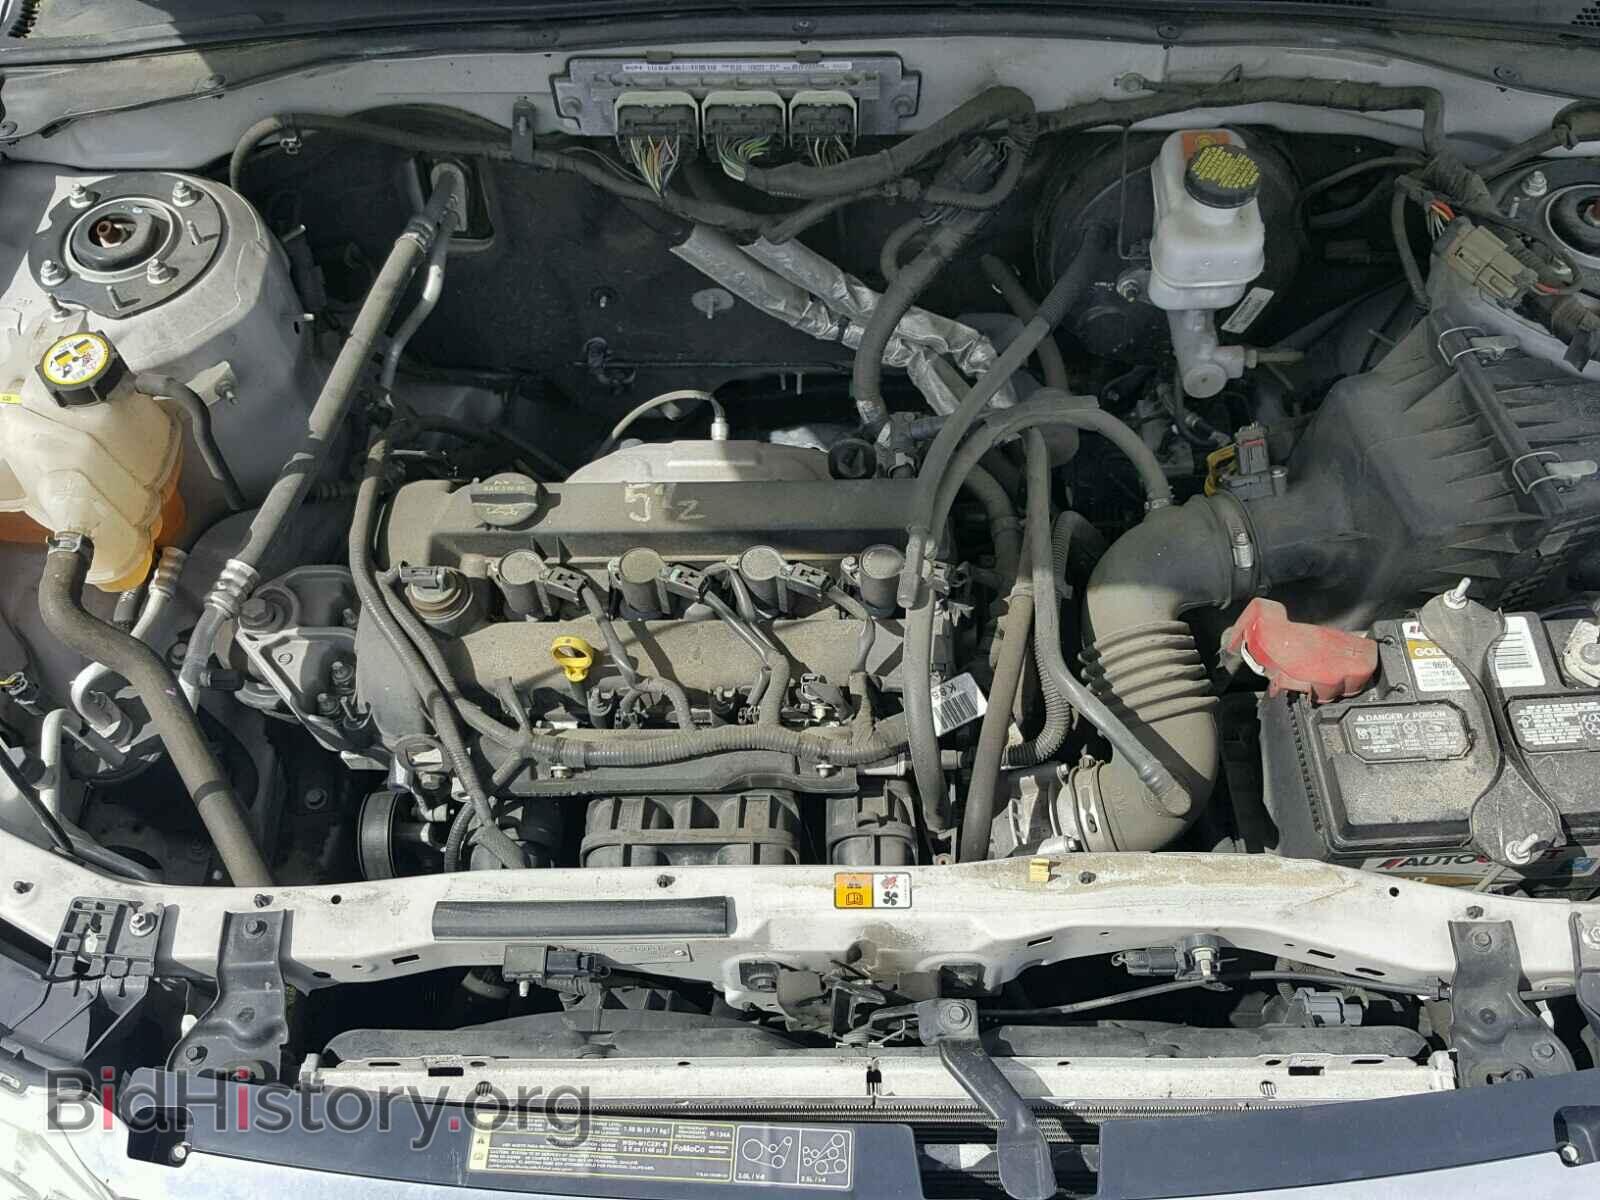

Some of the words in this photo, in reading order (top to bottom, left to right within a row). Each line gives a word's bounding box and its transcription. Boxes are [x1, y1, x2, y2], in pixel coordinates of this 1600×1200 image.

[1414, 647, 1448, 657] GOL
[1366, 711, 1403, 721] DANGER
[1412, 710, 1446, 719] POISON
[673, 1143, 706, 1154] FoMoCo
